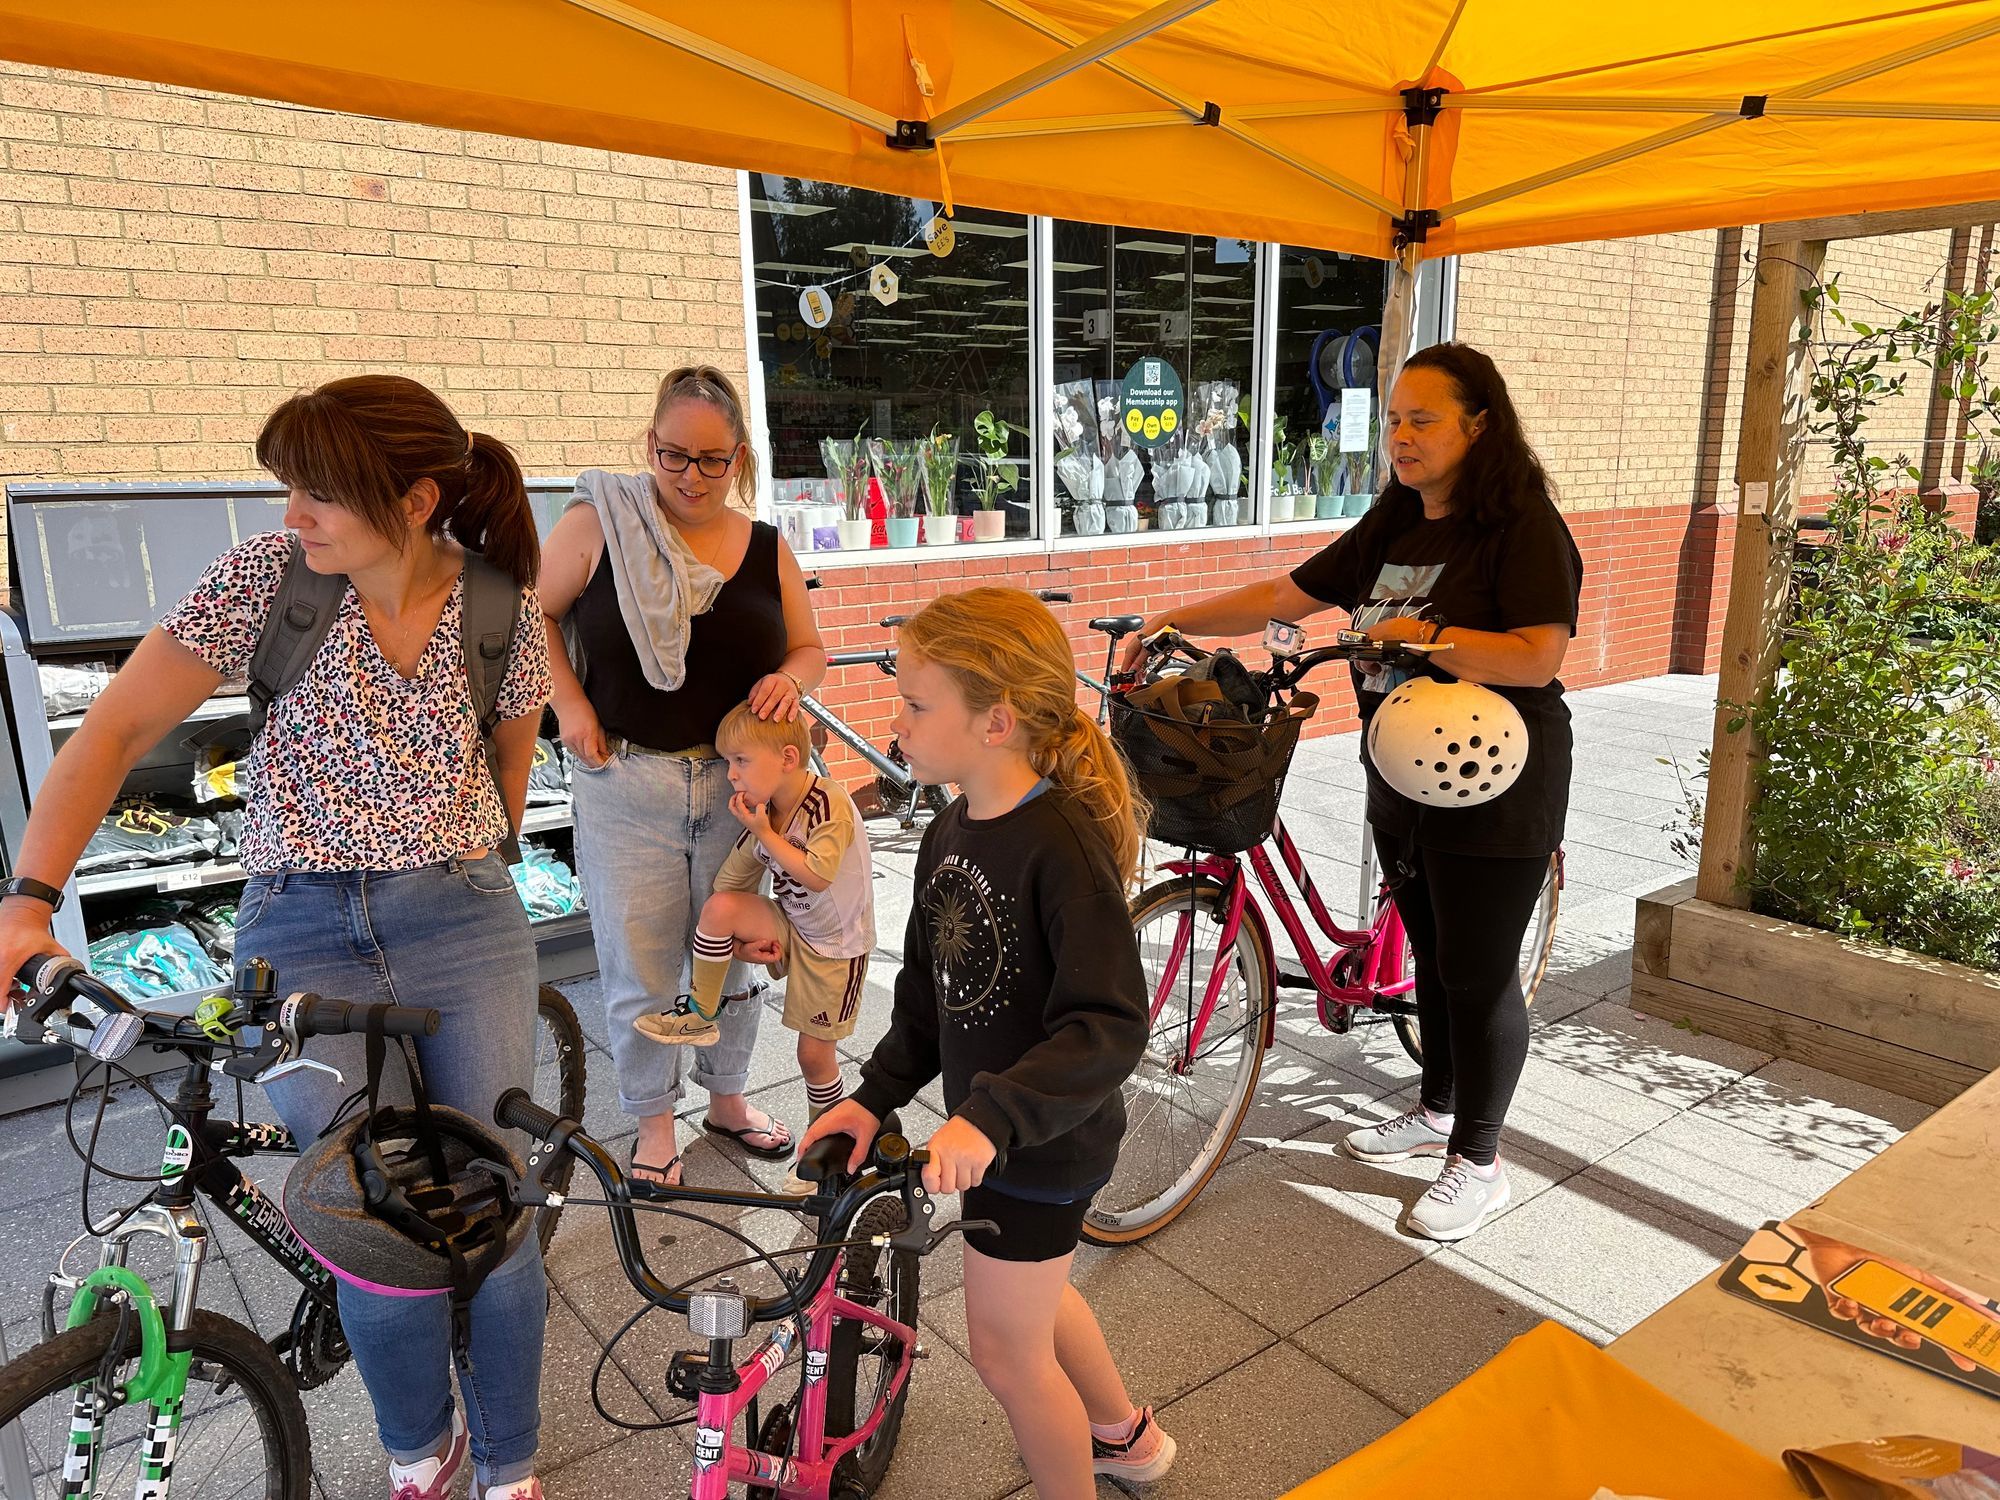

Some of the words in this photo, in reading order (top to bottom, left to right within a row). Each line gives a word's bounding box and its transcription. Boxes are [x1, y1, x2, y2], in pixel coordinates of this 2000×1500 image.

[927, 223, 948, 244] Save
[1088, 318, 1095, 334] 3
[1164, 318, 1171, 333] 2
[1129, 388, 1161, 396] Download
[1125, 398, 1164, 406] Membership
[182, 873, 198, 881] £12
[961, 857, 968, 869] &
[970, 864, 992, 896] STARS
[285, 1002, 293, 1027] SRAM
[810, 1018, 831, 1028] adidas
[806, 1365, 825, 1375] CENT
[696, 1445, 720, 1459] CENT
